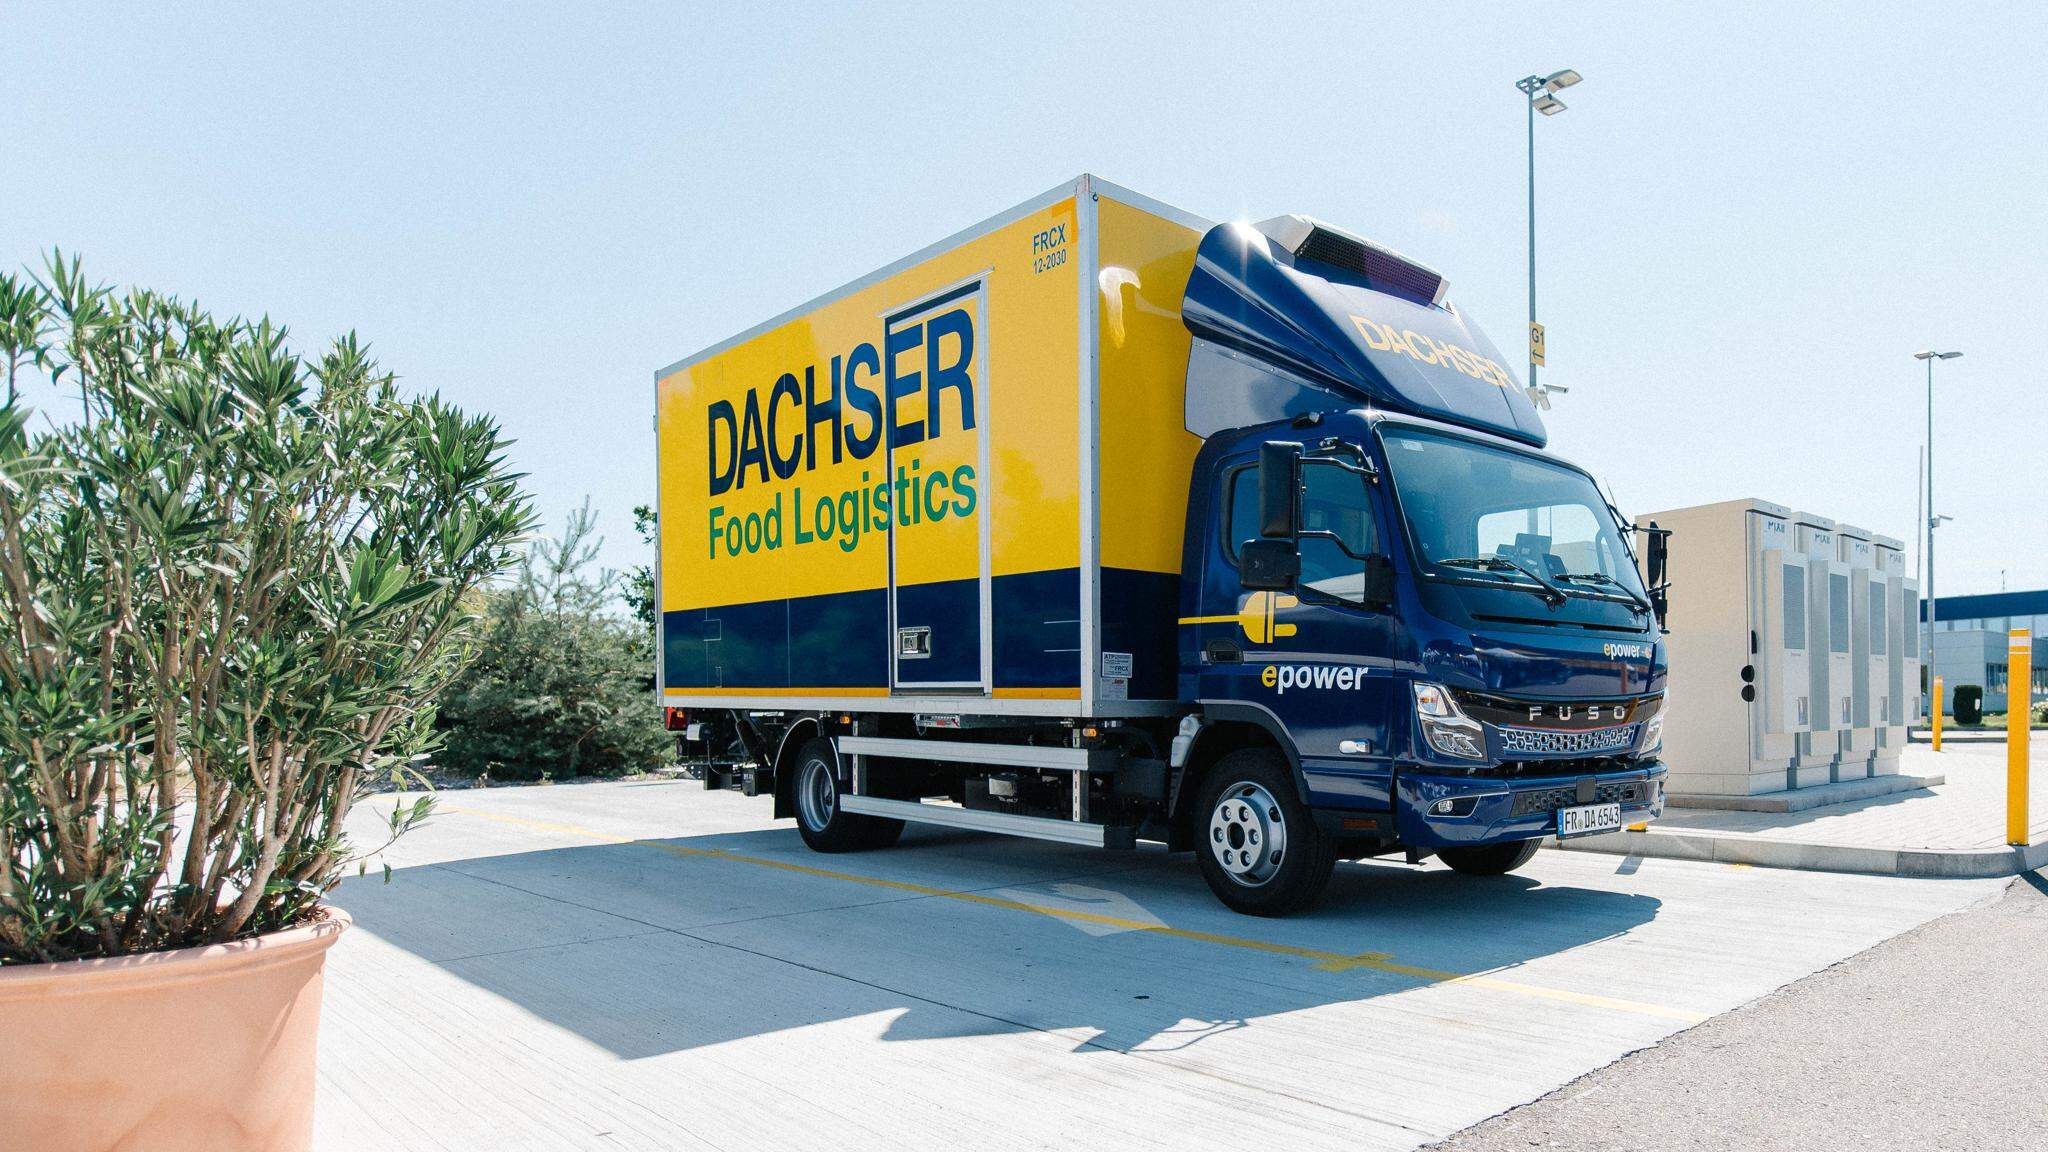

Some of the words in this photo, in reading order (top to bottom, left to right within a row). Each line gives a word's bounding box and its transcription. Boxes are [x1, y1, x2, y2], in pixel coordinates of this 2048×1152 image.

[1033, 223, 1066, 255] FRCX
[1033, 249, 1067, 275] 12-2030
[1532, 327, 1544, 346] G1
[1349, 314, 1521, 394] DACHSER
[708, 309, 977, 497] DACHSER
[709, 493, 783, 560] Food
[795, 459, 977, 552] Logistics
[1603, 643, 1641, 660] epower
[1261, 665, 1369, 695] epower
[1529, 706, 1626, 721] FUSO
[1565, 811, 1577, 831] FR
[1584, 809, 1596, 828] DA
[1598, 806, 1619, 826] 6543
